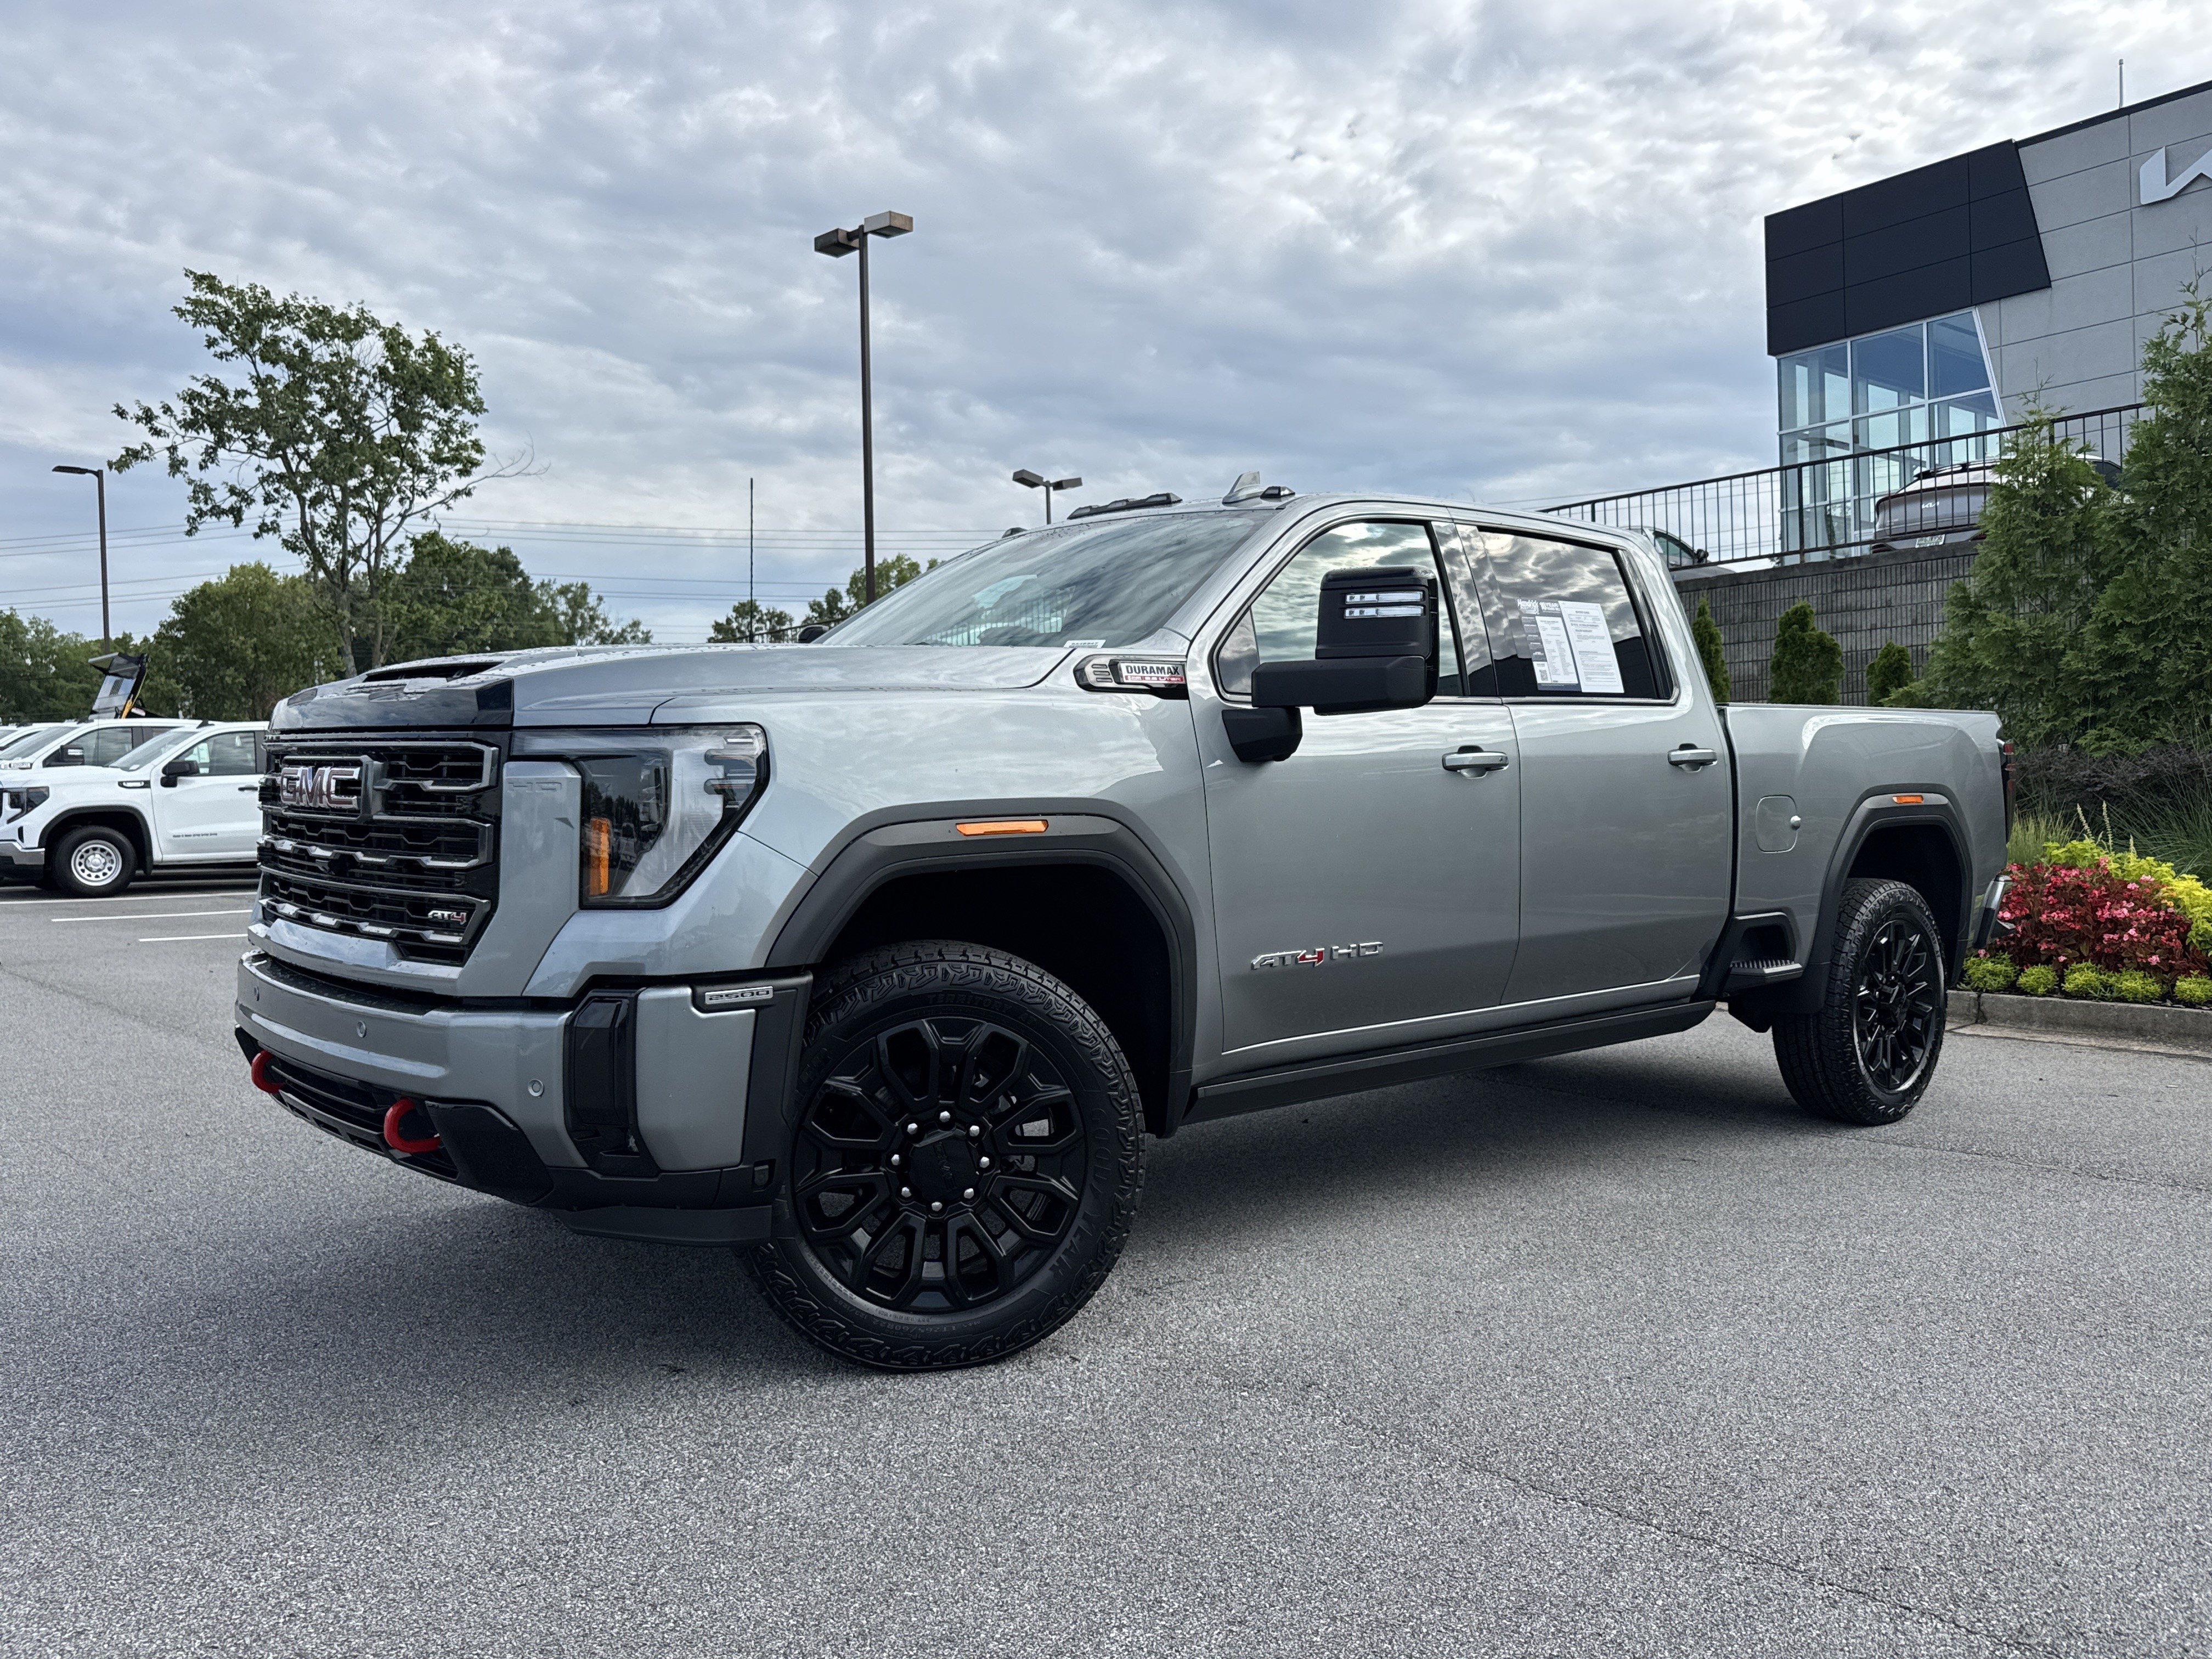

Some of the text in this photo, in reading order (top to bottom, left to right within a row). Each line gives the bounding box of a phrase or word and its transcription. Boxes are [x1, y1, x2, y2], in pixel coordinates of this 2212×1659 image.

[1126, 665, 1180, 675] DURAMAX
[280, 766, 360, 809] GMC
[428, 910, 467, 925] AT4
[1251, 941, 1384, 970] AT4 HD
[709, 990, 770, 1001] 2500
[928, 994, 1013, 1013] TERRITORY
[1049, 1107, 1111, 1279] GOODYEAR
